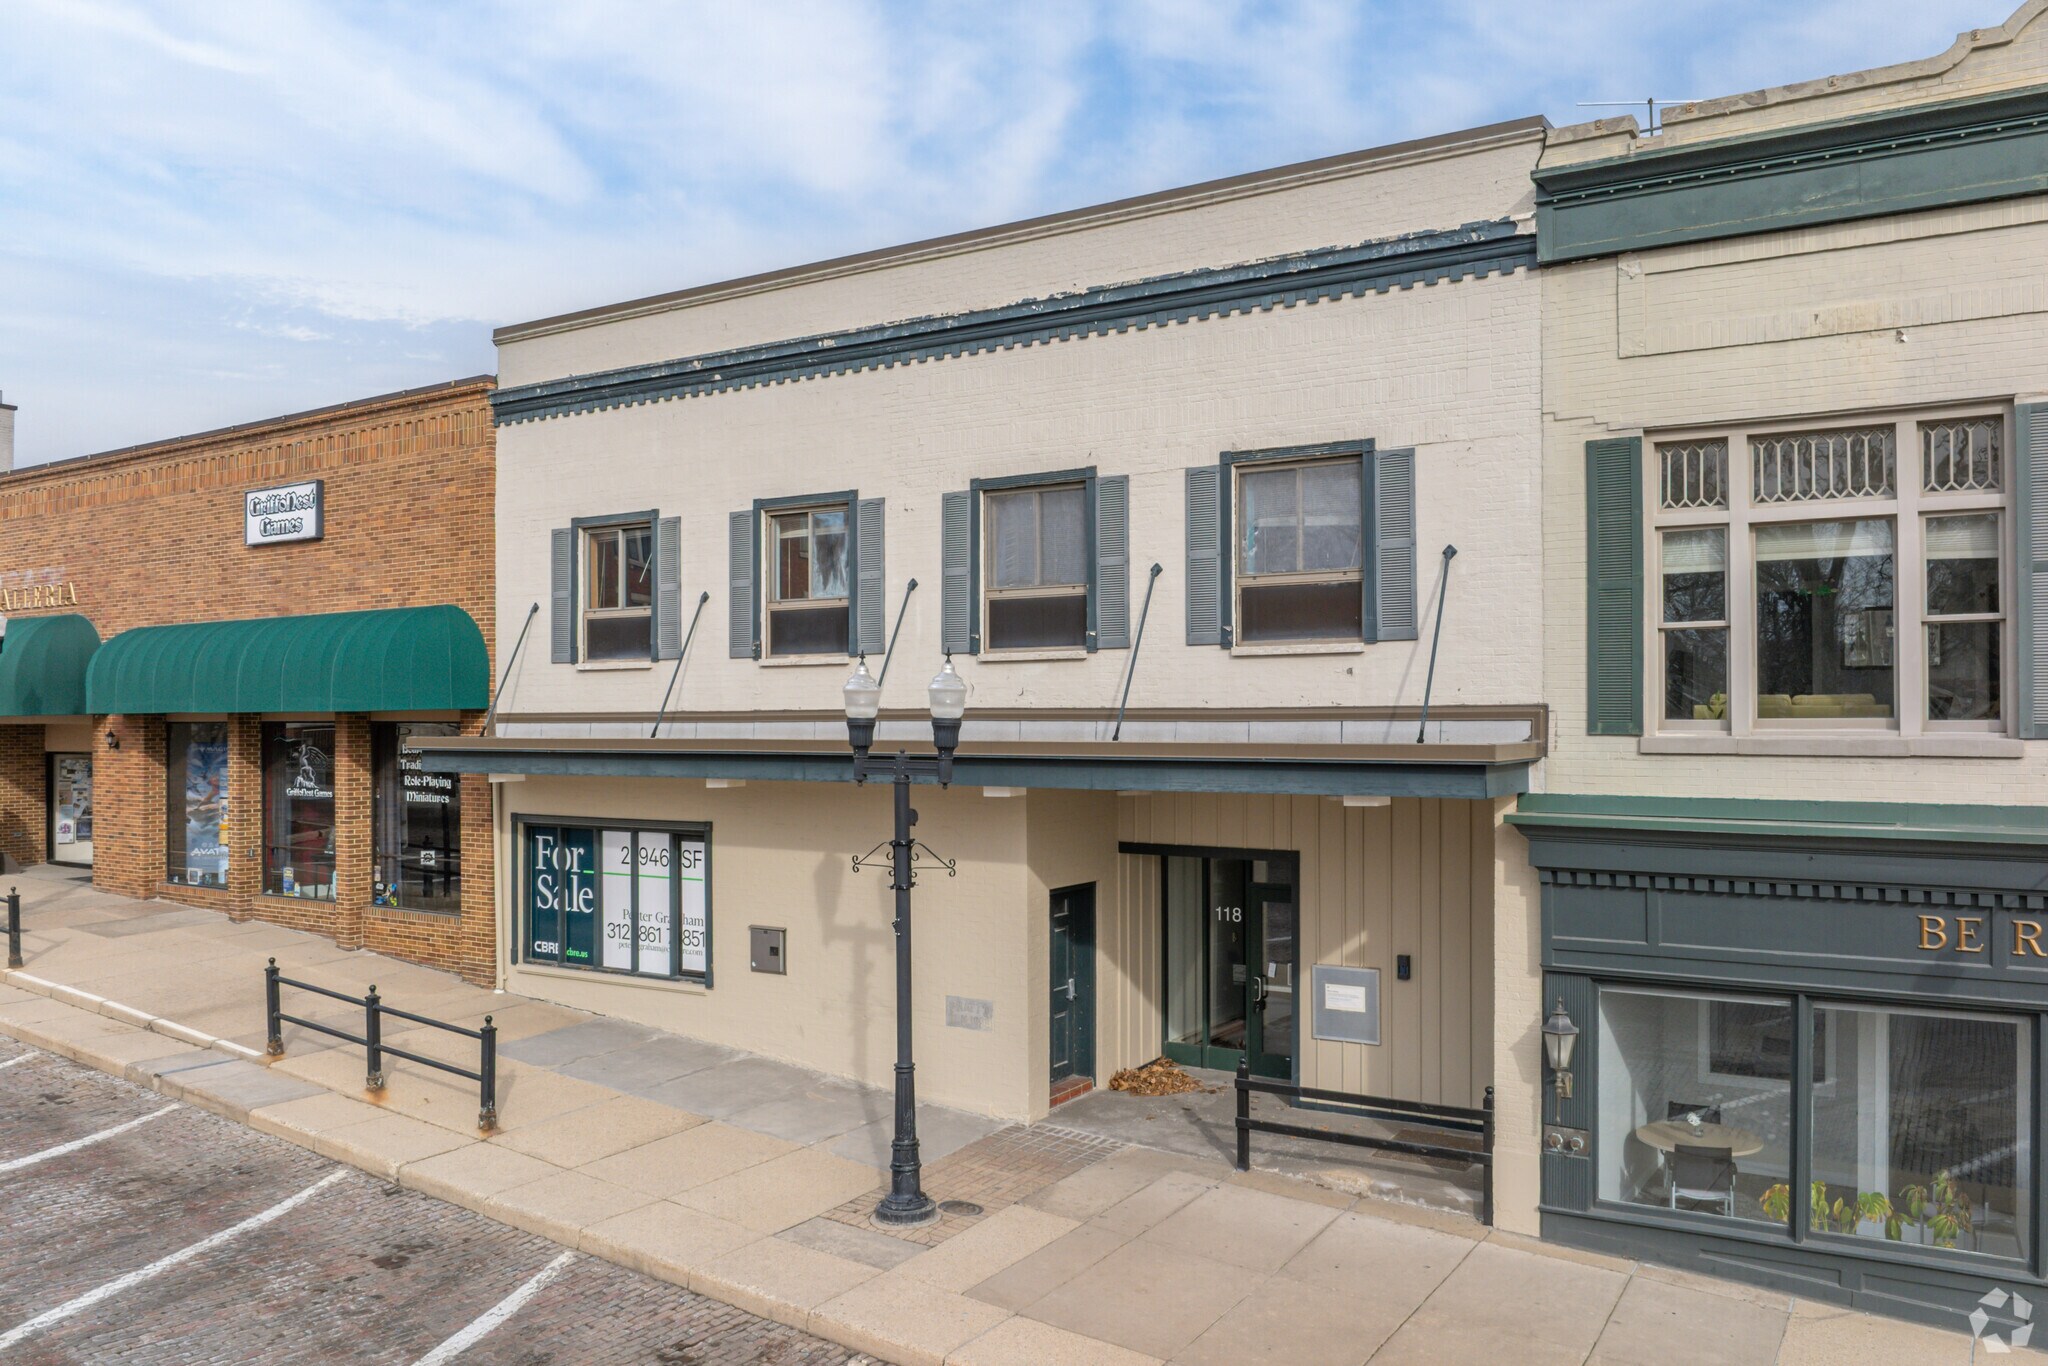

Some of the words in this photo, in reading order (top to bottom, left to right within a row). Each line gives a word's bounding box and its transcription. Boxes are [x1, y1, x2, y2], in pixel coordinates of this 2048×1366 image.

[249, 488, 316, 517] GriffoNest
[259, 517, 304, 537] Games
[404, 775, 451, 789] Role-Playing
[314, 788, 333, 798] Games
[406, 791, 450, 803] Miniatures
[535, 835, 585, 873] For
[682, 849, 702, 869] SF
[537, 874, 594, 913] Sale
[1215, 906, 1242, 922] 118
[607, 922, 631, 940] 312
[638, 925, 662, 944] 861
